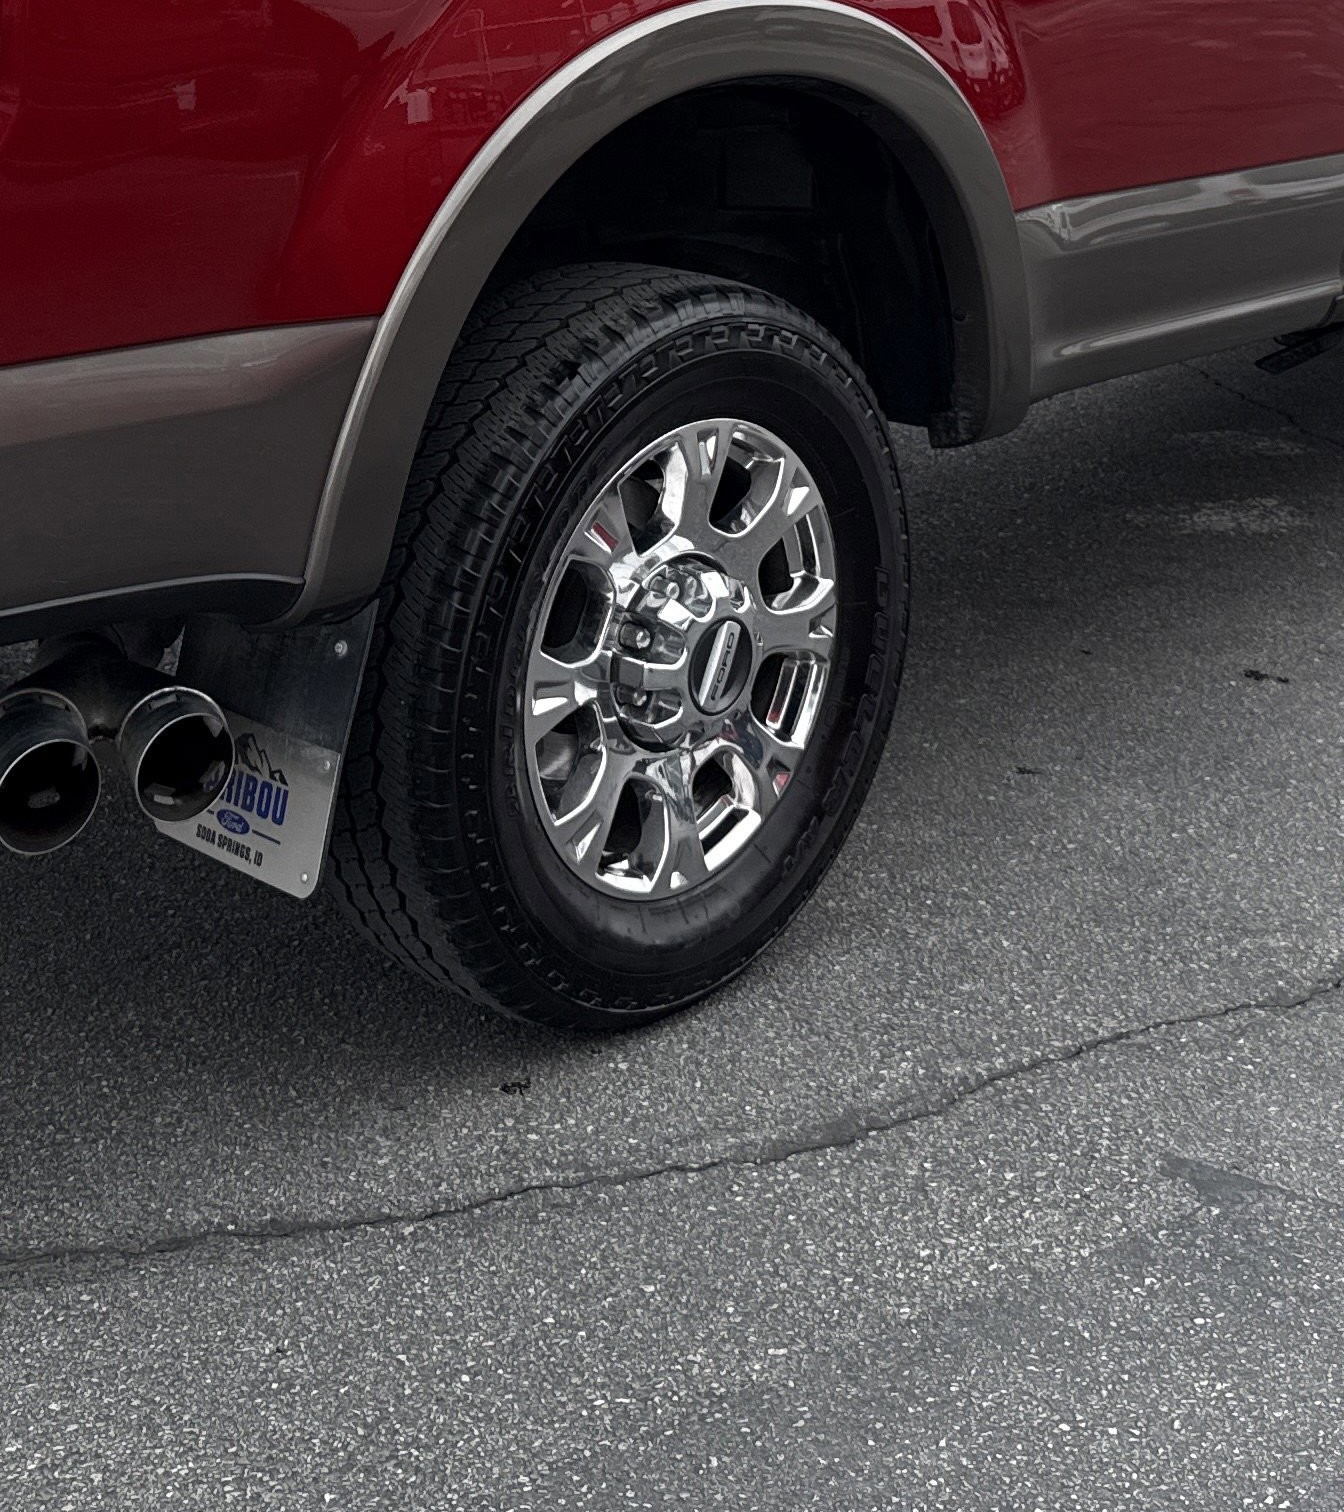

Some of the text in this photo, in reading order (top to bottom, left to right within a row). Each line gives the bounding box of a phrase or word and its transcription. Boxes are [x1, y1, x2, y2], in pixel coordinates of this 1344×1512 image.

[710, 631, 735, 701] FORD
[221, 769, 288, 825] RIBOU
[195, 823, 263, 866] SODA SPRINGS, ID
